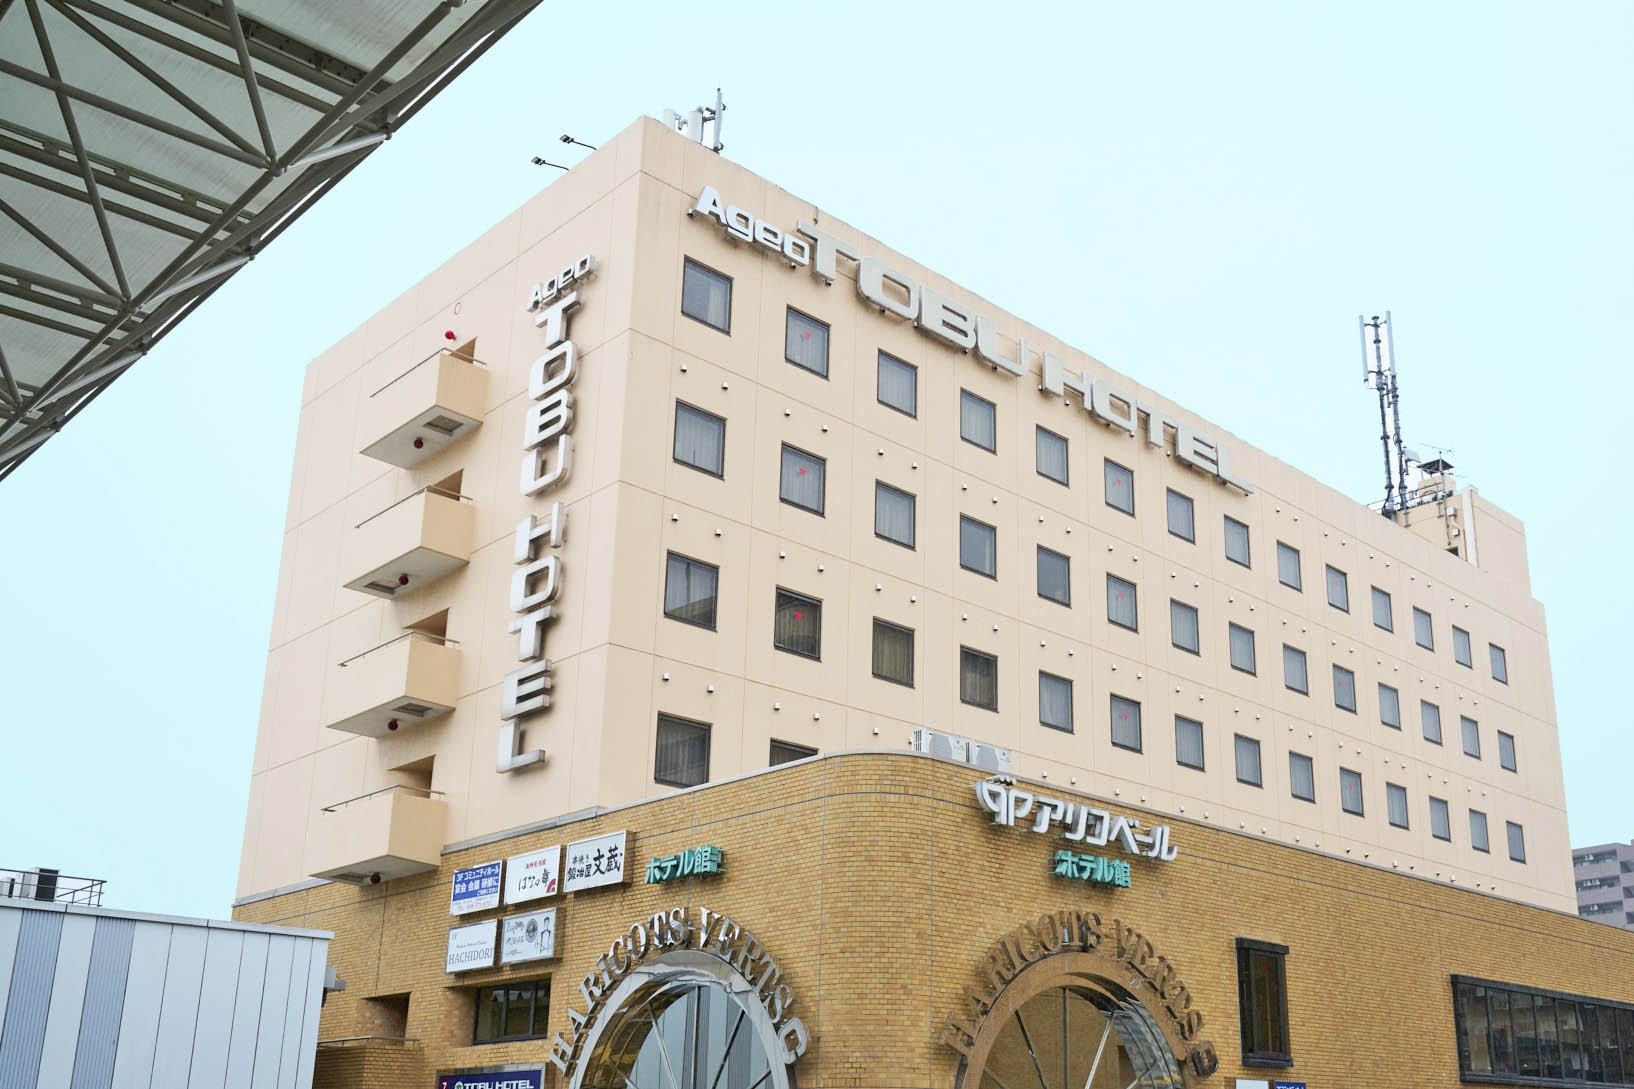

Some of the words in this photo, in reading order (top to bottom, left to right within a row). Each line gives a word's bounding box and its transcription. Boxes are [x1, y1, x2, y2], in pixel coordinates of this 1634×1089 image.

[526, 254, 595, 313] Ageo
[695, 185, 810, 266] Ageo
[796, 219, 1029, 377] TOBU
[1042, 351, 1257, 495] HOTEL
[520, 290, 582, 497] TOBU
[496, 502, 567, 774] HOTEL
[1033, 795, 1178, 861] アリコベール
[644, 844, 718, 884] ホテル館
[1055, 850, 1131, 888] ホテル館
[448, 947, 493, 965] HACHIDORI
[939, 910, 1102, 1055] HARICOTS
[549, 907, 692, 1078] HARICOTS
[700, 906, 793, 1025] VERTS
[495, 1080, 535, 1089] HOTEL
